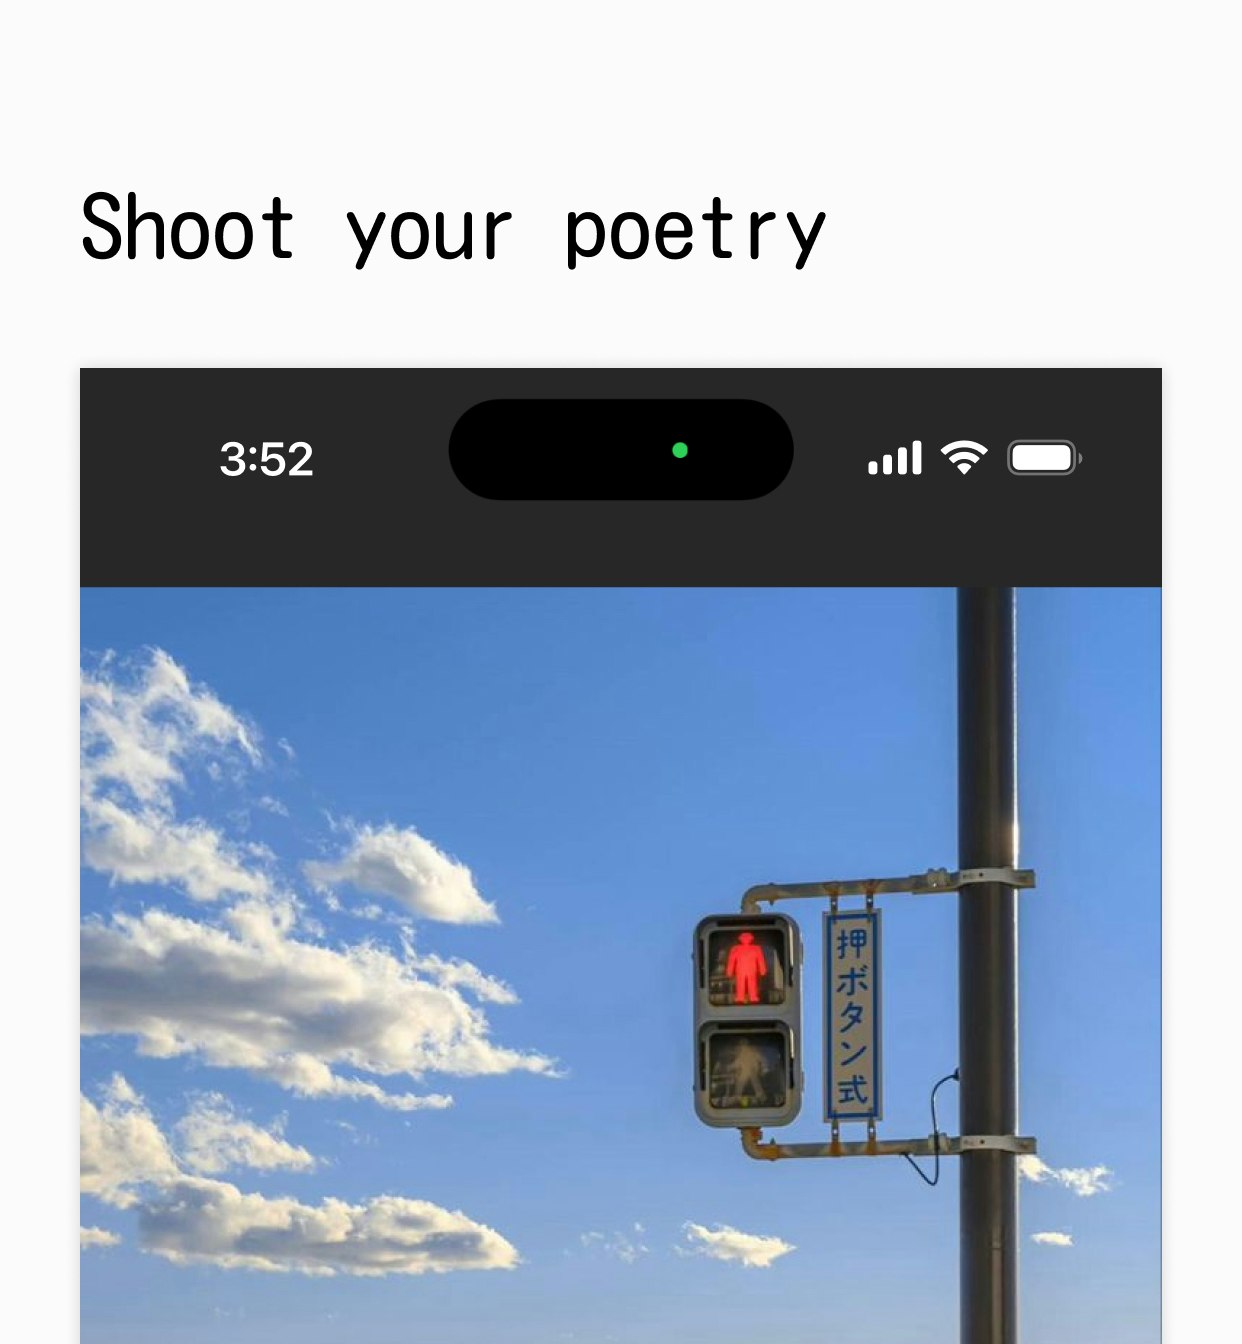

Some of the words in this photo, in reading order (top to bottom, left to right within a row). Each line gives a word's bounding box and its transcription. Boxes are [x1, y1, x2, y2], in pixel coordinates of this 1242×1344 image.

[219, 441, 314, 477] 3:52
[836, 929, 868, 1105] 押ボタン式
